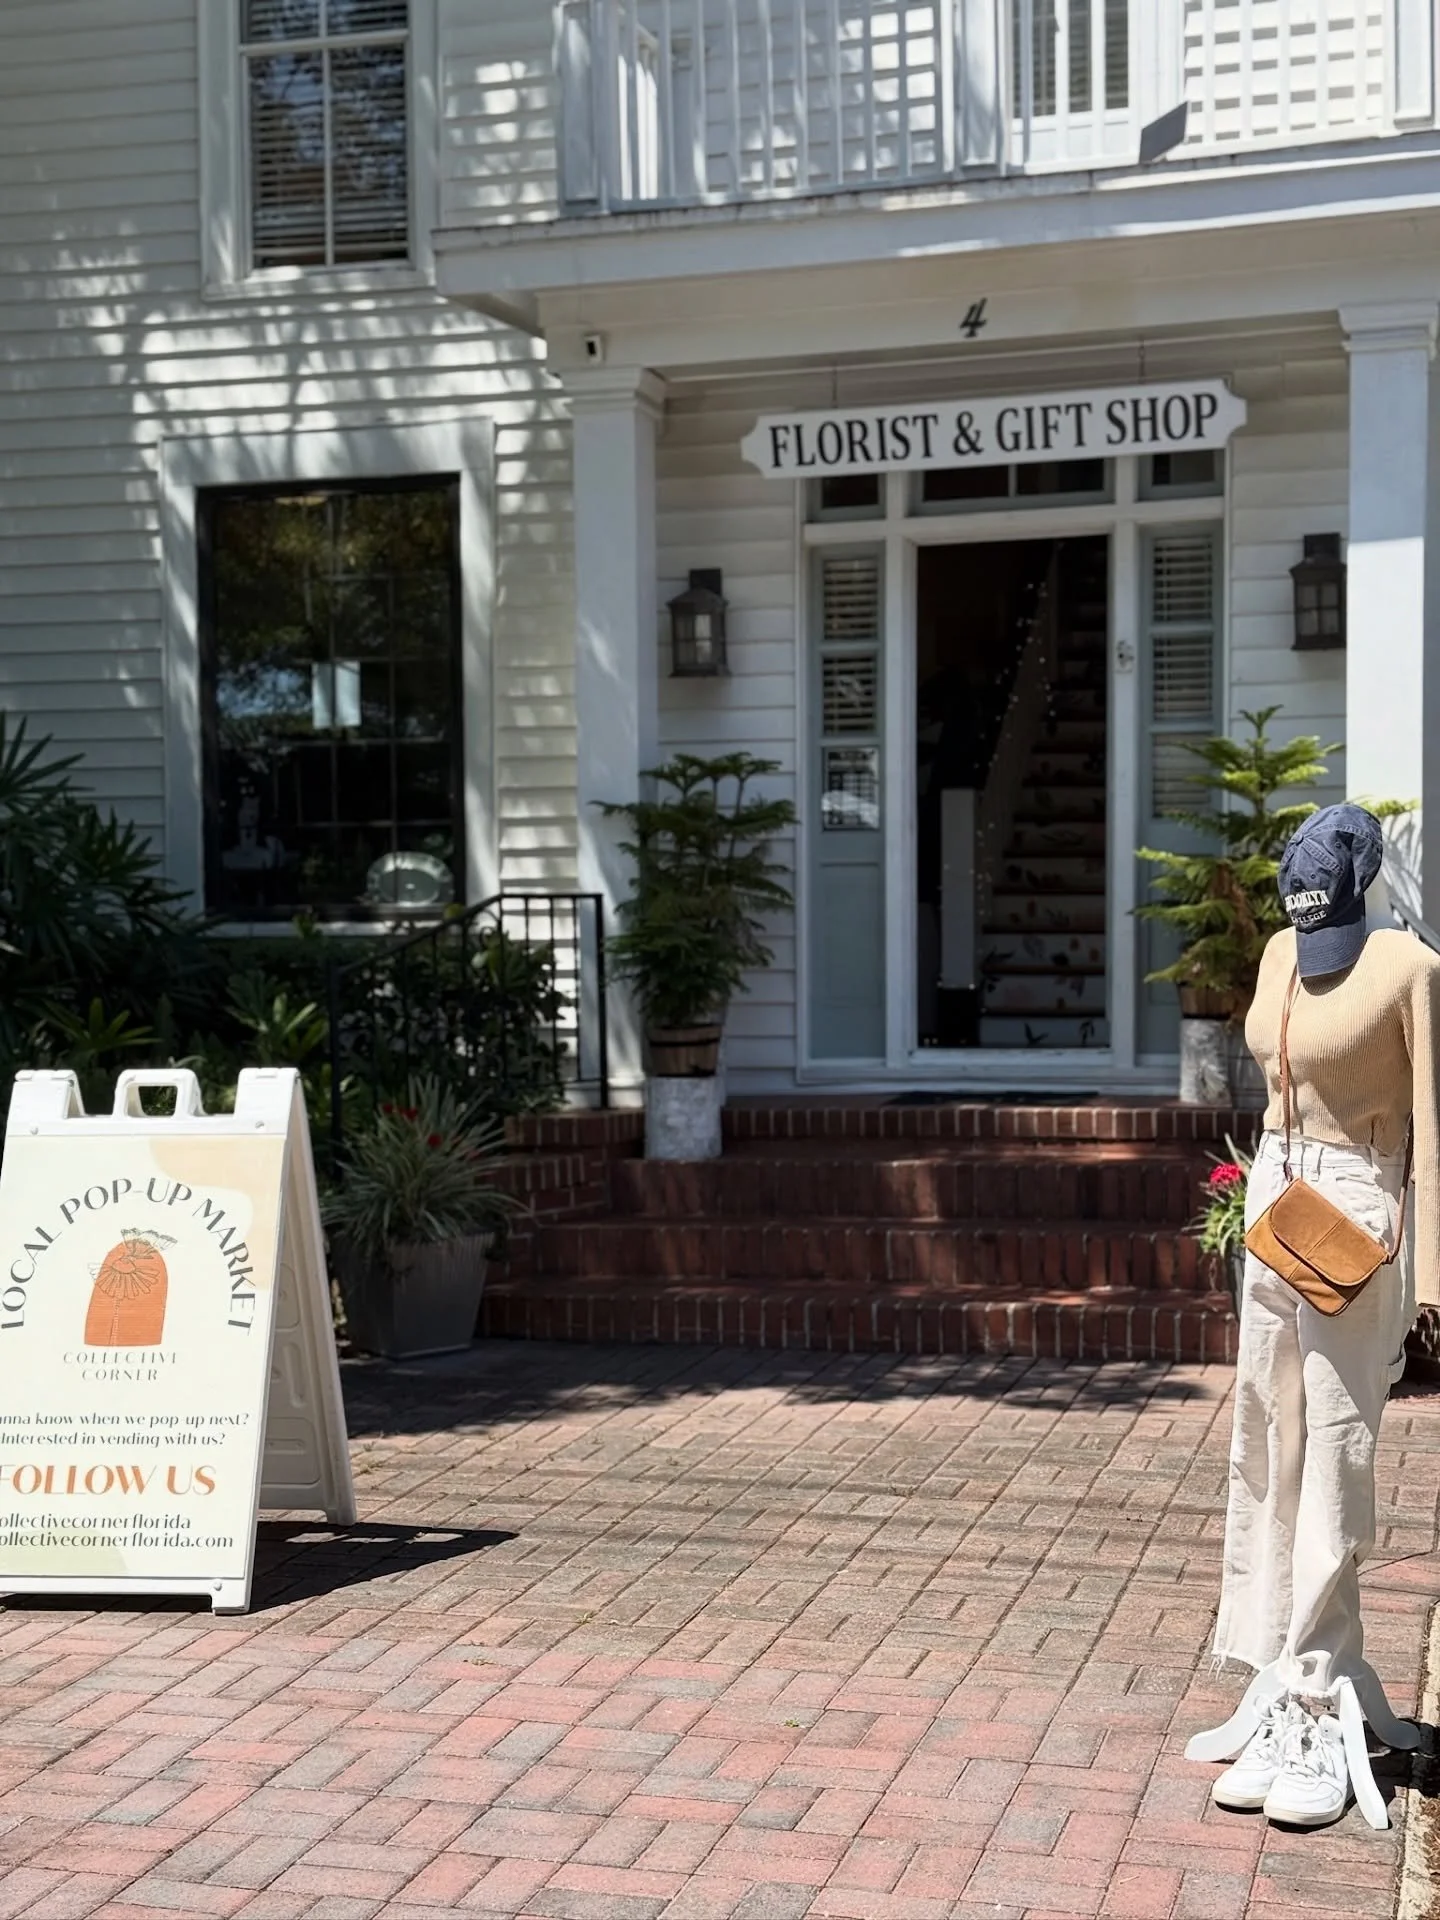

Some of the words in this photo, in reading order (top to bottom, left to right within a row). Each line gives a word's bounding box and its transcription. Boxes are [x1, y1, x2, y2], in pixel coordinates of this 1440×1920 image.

[960, 298, 988, 337] 4
[769, 414, 938, 469] FLORIST
[953, 410, 985, 456] &
[995, 402, 1092, 453] GIFT
[1106, 392, 1219, 445] SHOP
[1, 1226, 62, 1329] LOCAL
[59, 1178, 192, 1225] POP-UP
[192, 1198, 256, 1336] MARKET
[82, 1369, 158, 1381] CORNER
[0, 1415, 31, 1425] nna
[36, 1412, 73, 1425] know
[79, 1412, 120, 1425] when
[124, 1415, 145, 1425] we
[209, 1413, 249, 1425] next?
[1, 1432, 78, 1445] Interested
[82, 1432, 96, 1445] in
[100, 1432, 160, 1449] vending
[165, 1432, 197, 1445] with
[201, 1433, 226, 1445] us?
[167, 1464, 217, 1496] US
